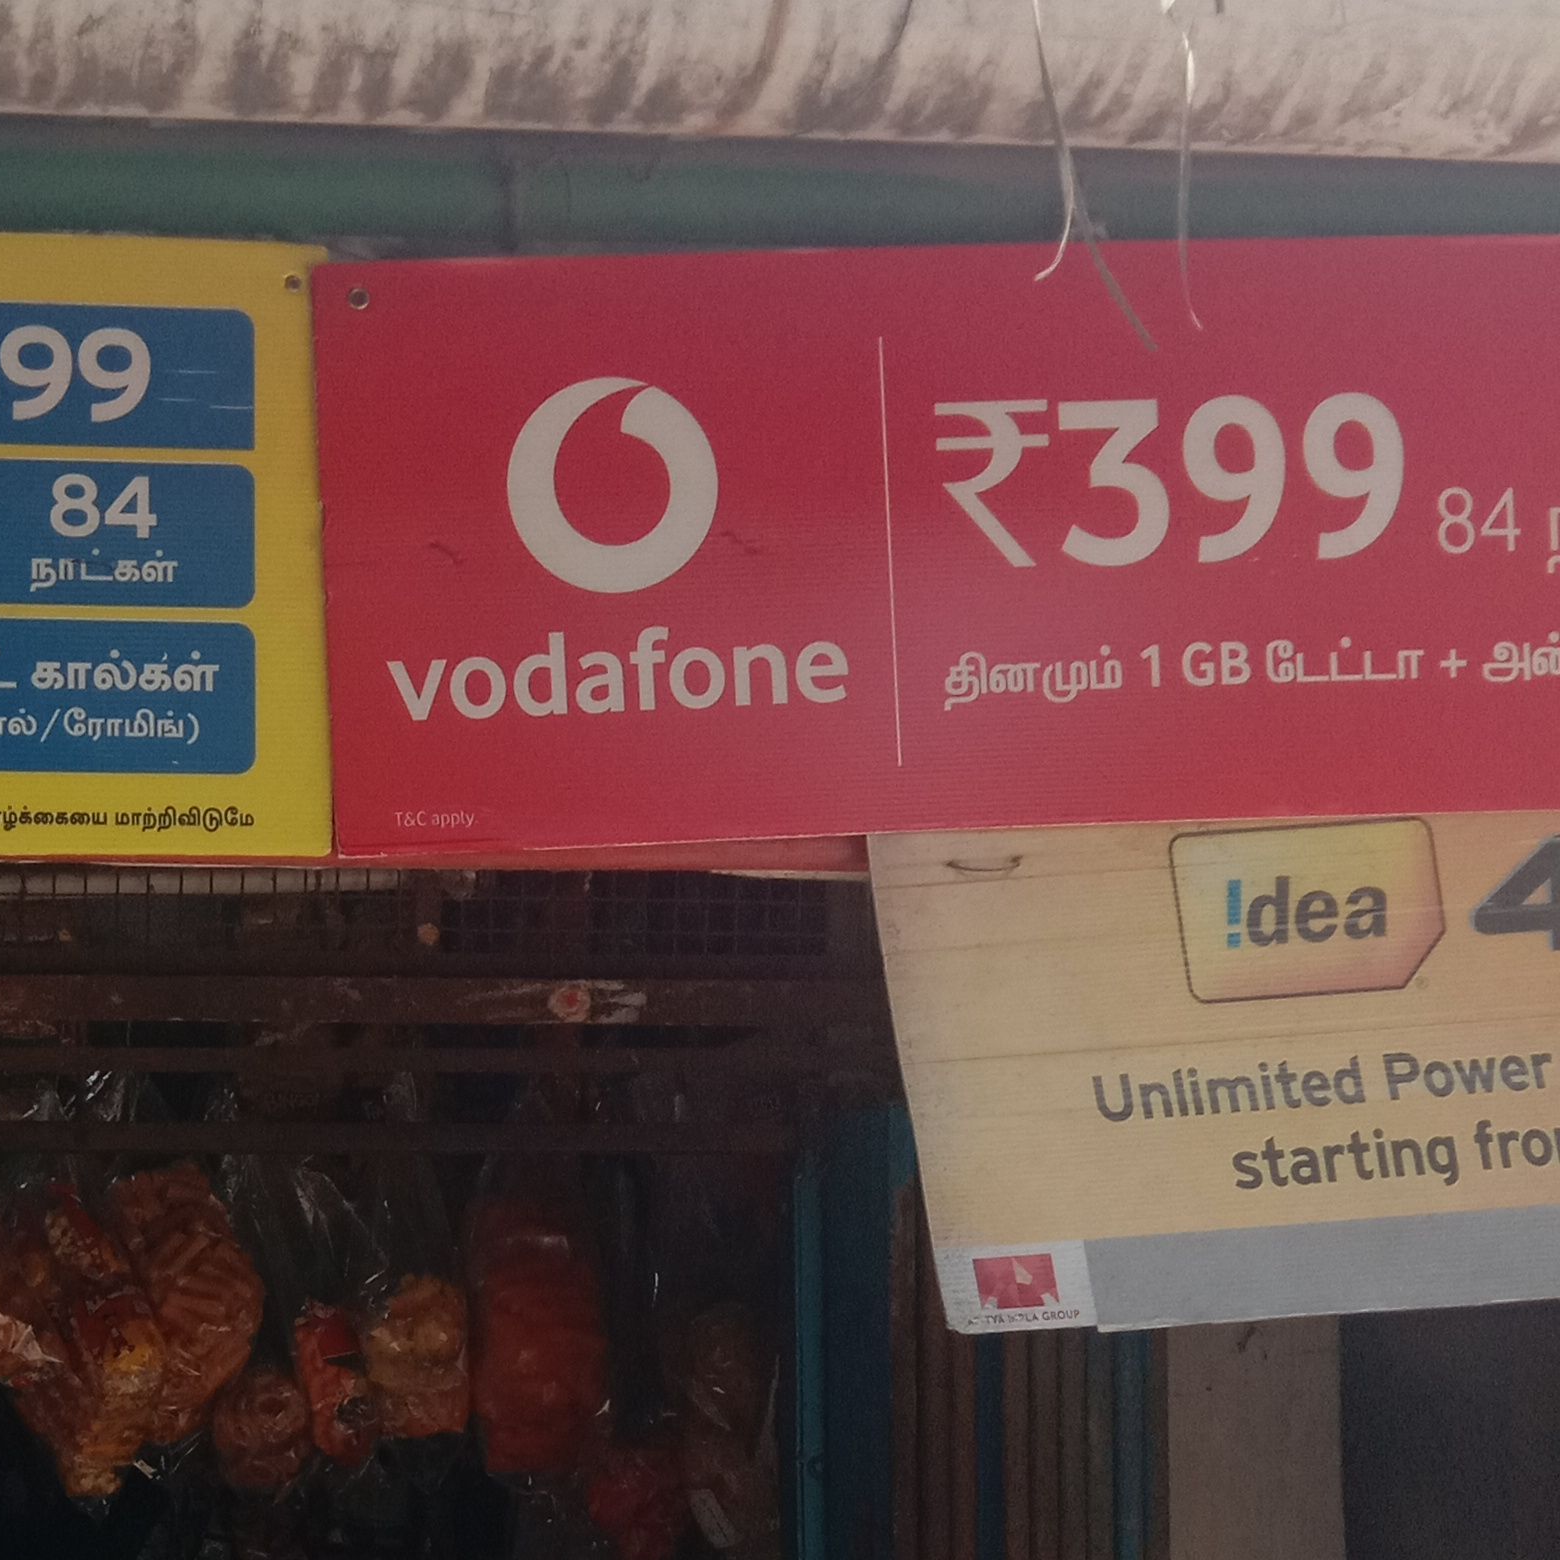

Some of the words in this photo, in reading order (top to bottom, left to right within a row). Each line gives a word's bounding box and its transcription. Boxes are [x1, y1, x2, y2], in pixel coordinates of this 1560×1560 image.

[50, 472, 158, 539] 84
[934, 391, 1405, 568] ₹399
[1436, 485, 1521, 554] 84
[29, 548, 179, 593] நாட்கள்
[30, 647, 220, 695] கால்கள்
[386, 626, 849, 721] vodafone
[943, 644, 1124, 711] தினமும்
[1139, 644, 1160, 688] 1
[1181, 640, 1253, 687] GB
[1265, 636, 1425, 684] டேட்டா
[113, 806, 256, 832] மாற்றிவிடுமே
[394, 811, 427, 827] T&C
[1091, 1054, 1367, 1123] Unlimited
[1382, 1051, 1553, 1101] Power
[1231, 1126, 1460, 1191] starting
[1041, 1309, 1081, 1321] GROUP
